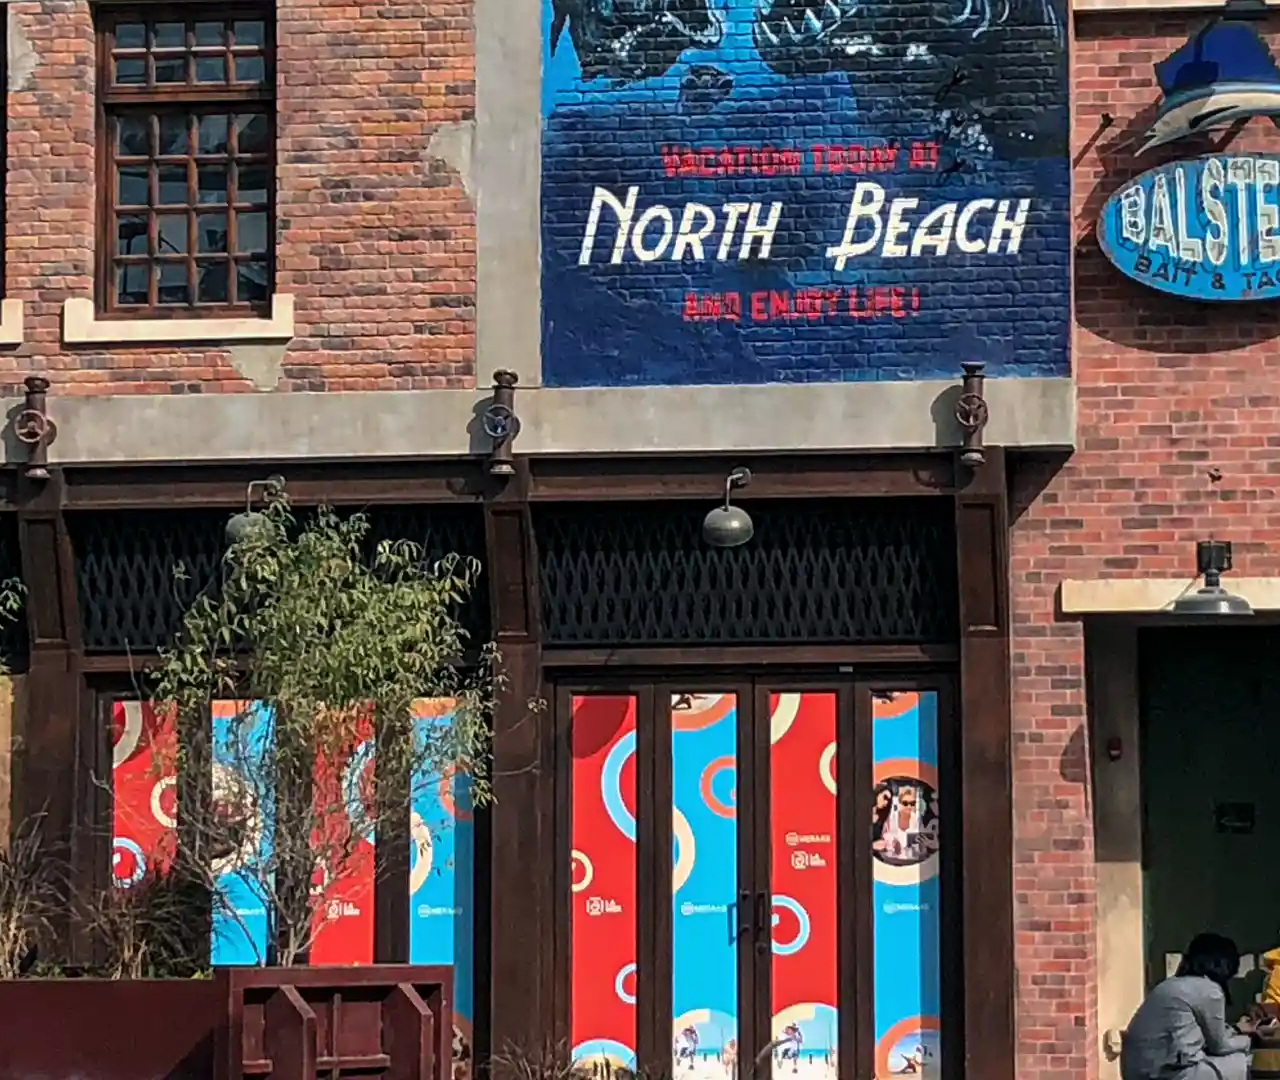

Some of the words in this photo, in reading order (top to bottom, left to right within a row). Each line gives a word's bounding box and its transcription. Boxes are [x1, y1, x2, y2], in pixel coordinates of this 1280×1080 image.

[578, 186, 783, 265] NORTH
[825, 181, 1031, 271] BEACH
[1134, 255, 1197, 287] BAIT
[1211, 272, 1226, 290] &
[683, 291, 742, 322] AND
[751, 287, 840, 321] ENJOY
